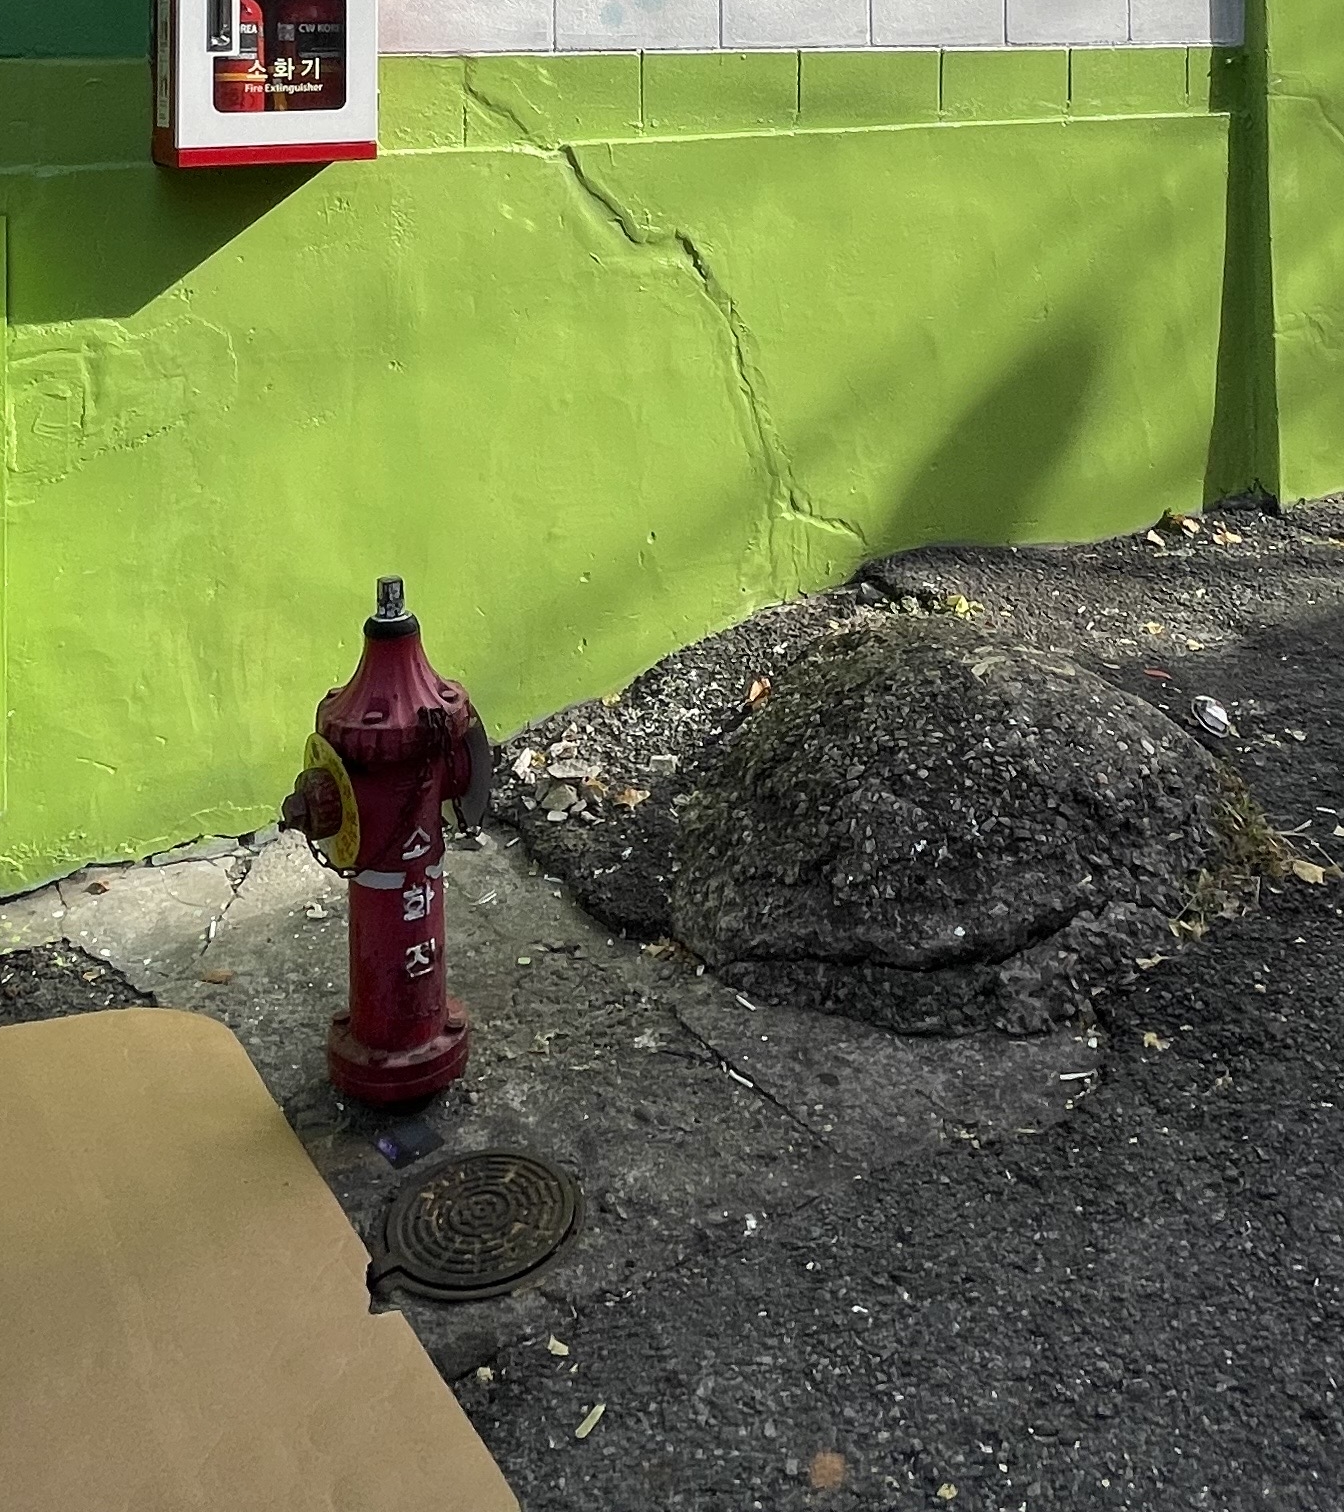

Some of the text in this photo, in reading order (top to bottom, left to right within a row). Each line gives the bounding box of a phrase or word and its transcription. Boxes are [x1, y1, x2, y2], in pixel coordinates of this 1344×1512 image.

[246, 57, 321, 81] 소화기
[244, 82, 324, 95] Fire Extinguisher
